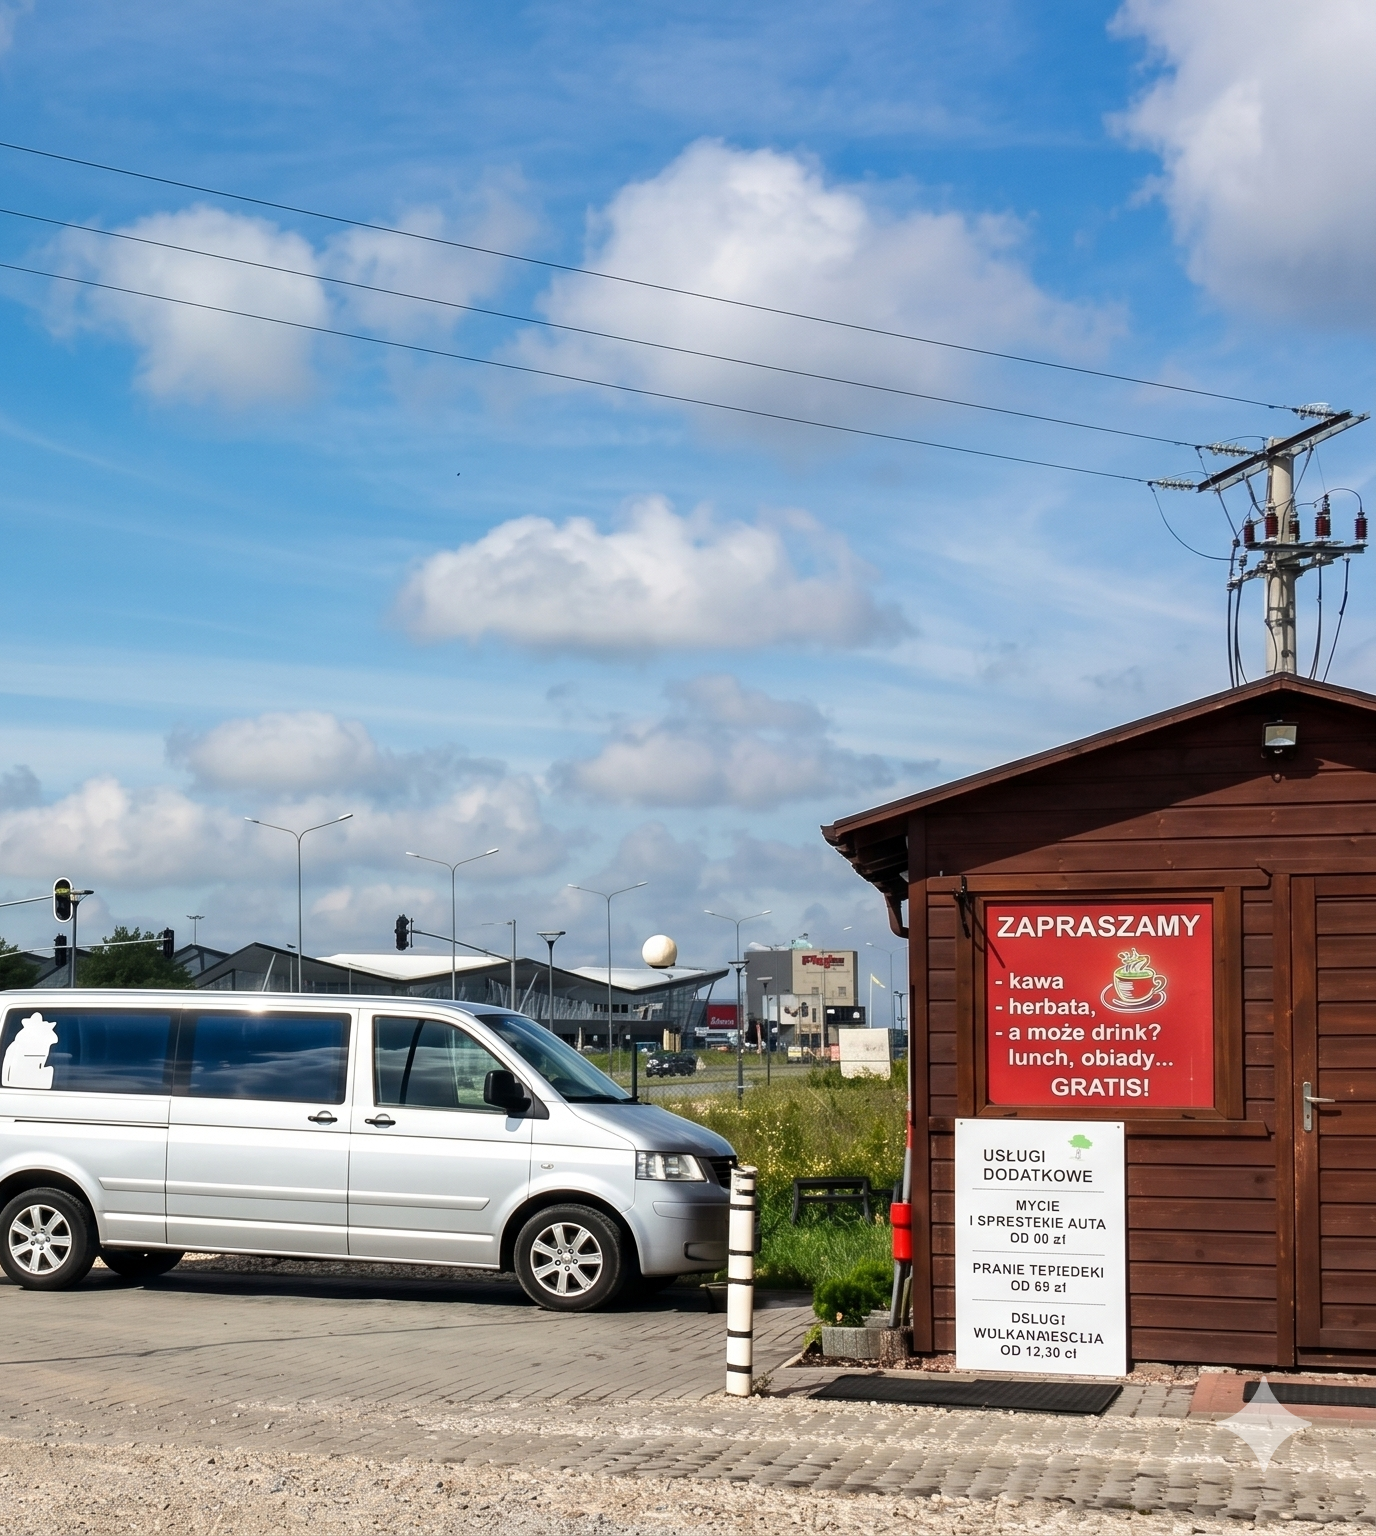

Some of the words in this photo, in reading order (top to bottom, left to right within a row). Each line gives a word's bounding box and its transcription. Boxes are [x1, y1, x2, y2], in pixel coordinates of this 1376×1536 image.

[997, 914, 1201, 938] ZAPRASZAMY
[1009, 972, 1064, 990] kawa
[1008, 998, 1097, 1018] herbata,
[1008, 1027, 1021, 1041] a
[1027, 1023, 1085, 1041] może
[1091, 1023, 1162, 1041] drink?
[1008, 1048, 1075, 1068] lunch,
[1081, 1049, 1174, 1071] obiady...
[1051, 1077, 1150, 1097] GRATIS!
[983, 1149, 1045, 1163] USŁUGI
[983, 1168, 1093, 1183] DODATKOWE
[1016, 1200, 1060, 1212] MYCIE
[977, 1215, 1064, 1229] SPRESTEKIE
[1068, 1218, 1107, 1230] AUTA
[1010, 1232, 1029, 1244] OD
[973, 1262, 1025, 1275] PRANIE
[1010, 1280, 1030, 1291] OD
[1034, 1281, 1050, 1292] 69
[1000, 1344, 1021, 1356] OD
[1026, 1345, 1061, 1359] 12,30
